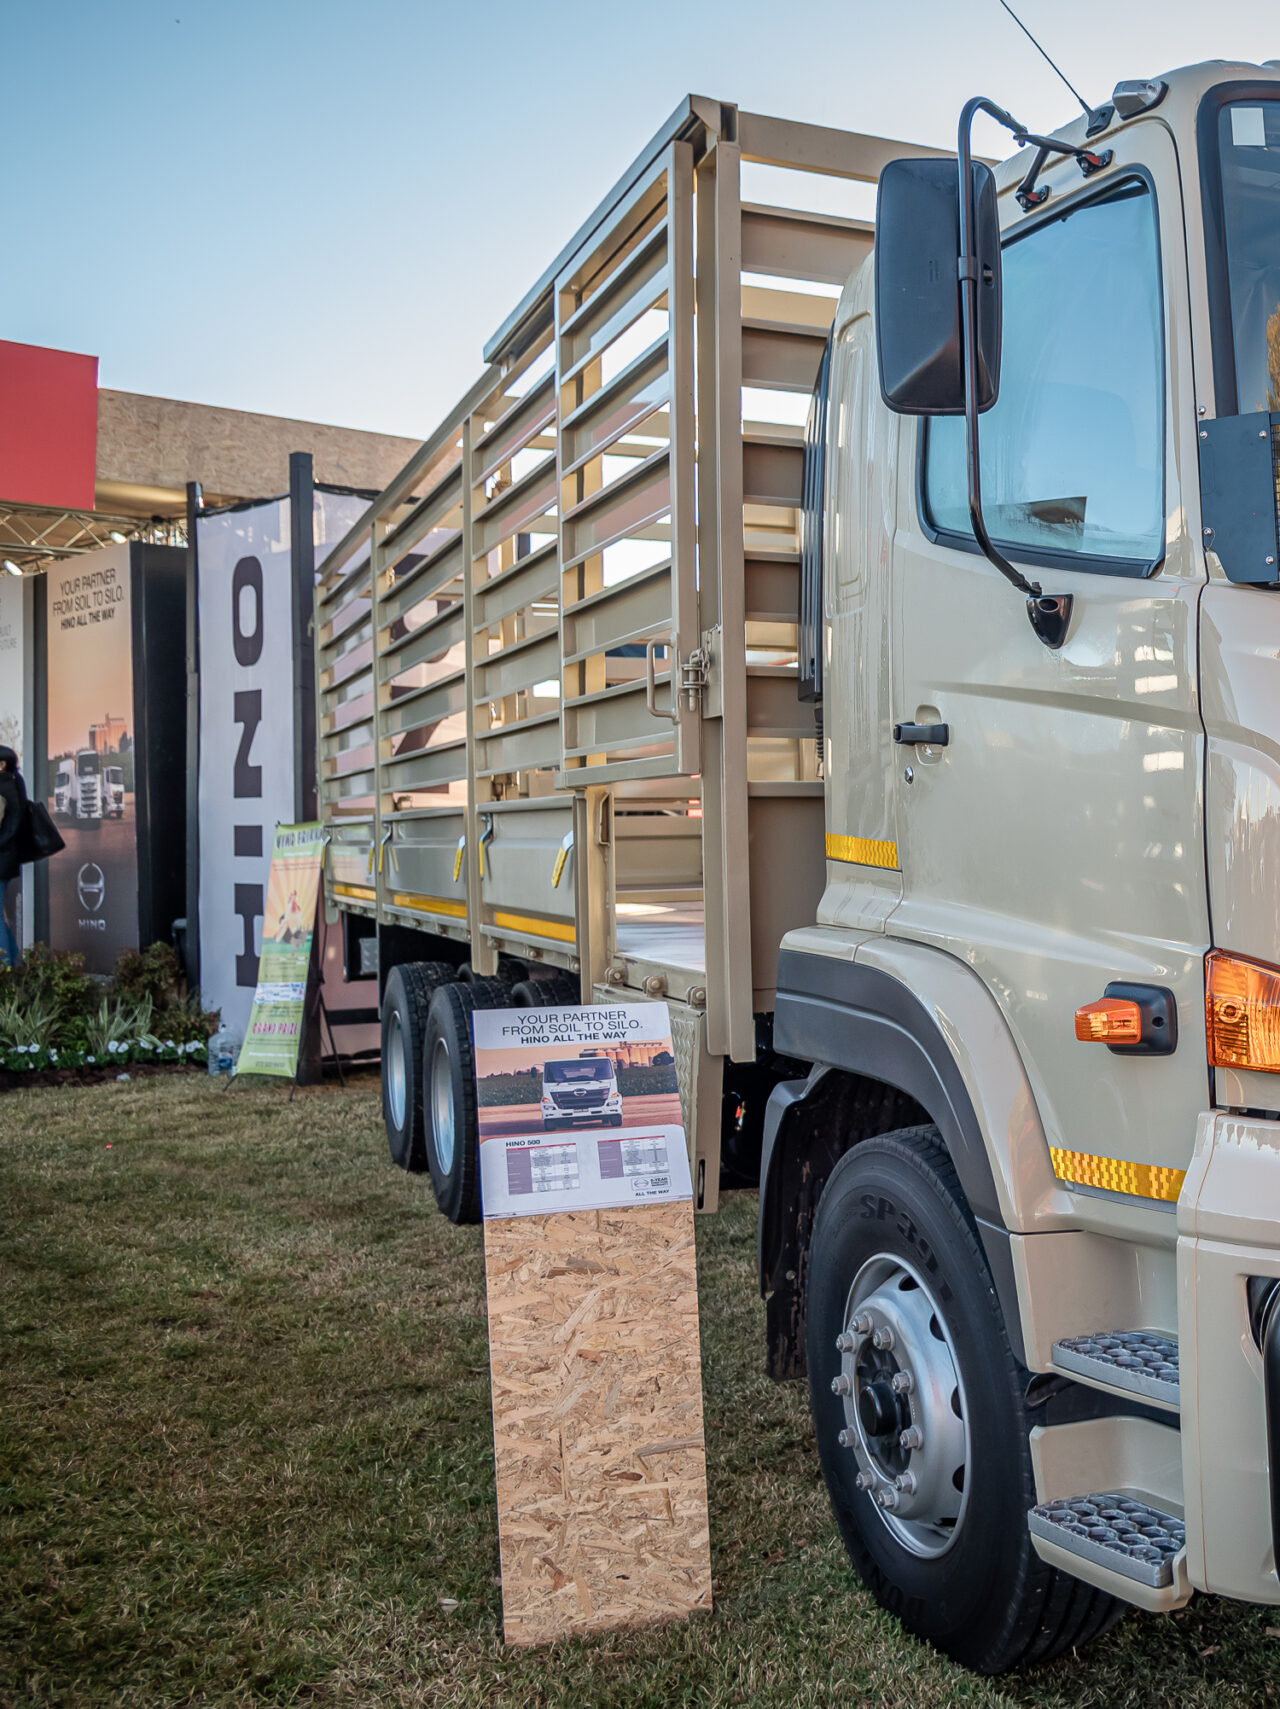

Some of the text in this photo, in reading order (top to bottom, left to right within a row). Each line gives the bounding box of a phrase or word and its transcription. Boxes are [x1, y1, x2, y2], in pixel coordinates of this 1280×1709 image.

[60, 568, 116, 596] YOUR PARTNER
[53, 598, 74, 616] FROM
[75, 594, 91, 611] SOIL
[93, 591, 103, 606] TO
[61, 607, 115, 630] HINO ALL THE WAY
[233, 555, 264, 988] HINO
[78, 919, 106, 931] HINO
[502, 1019, 643, 1036] FROM SOIL TO SILO.
[517, 1010, 627, 1025] YOUR PARTNER
[521, 1031, 627, 1044] HINO ALL THE WAY
